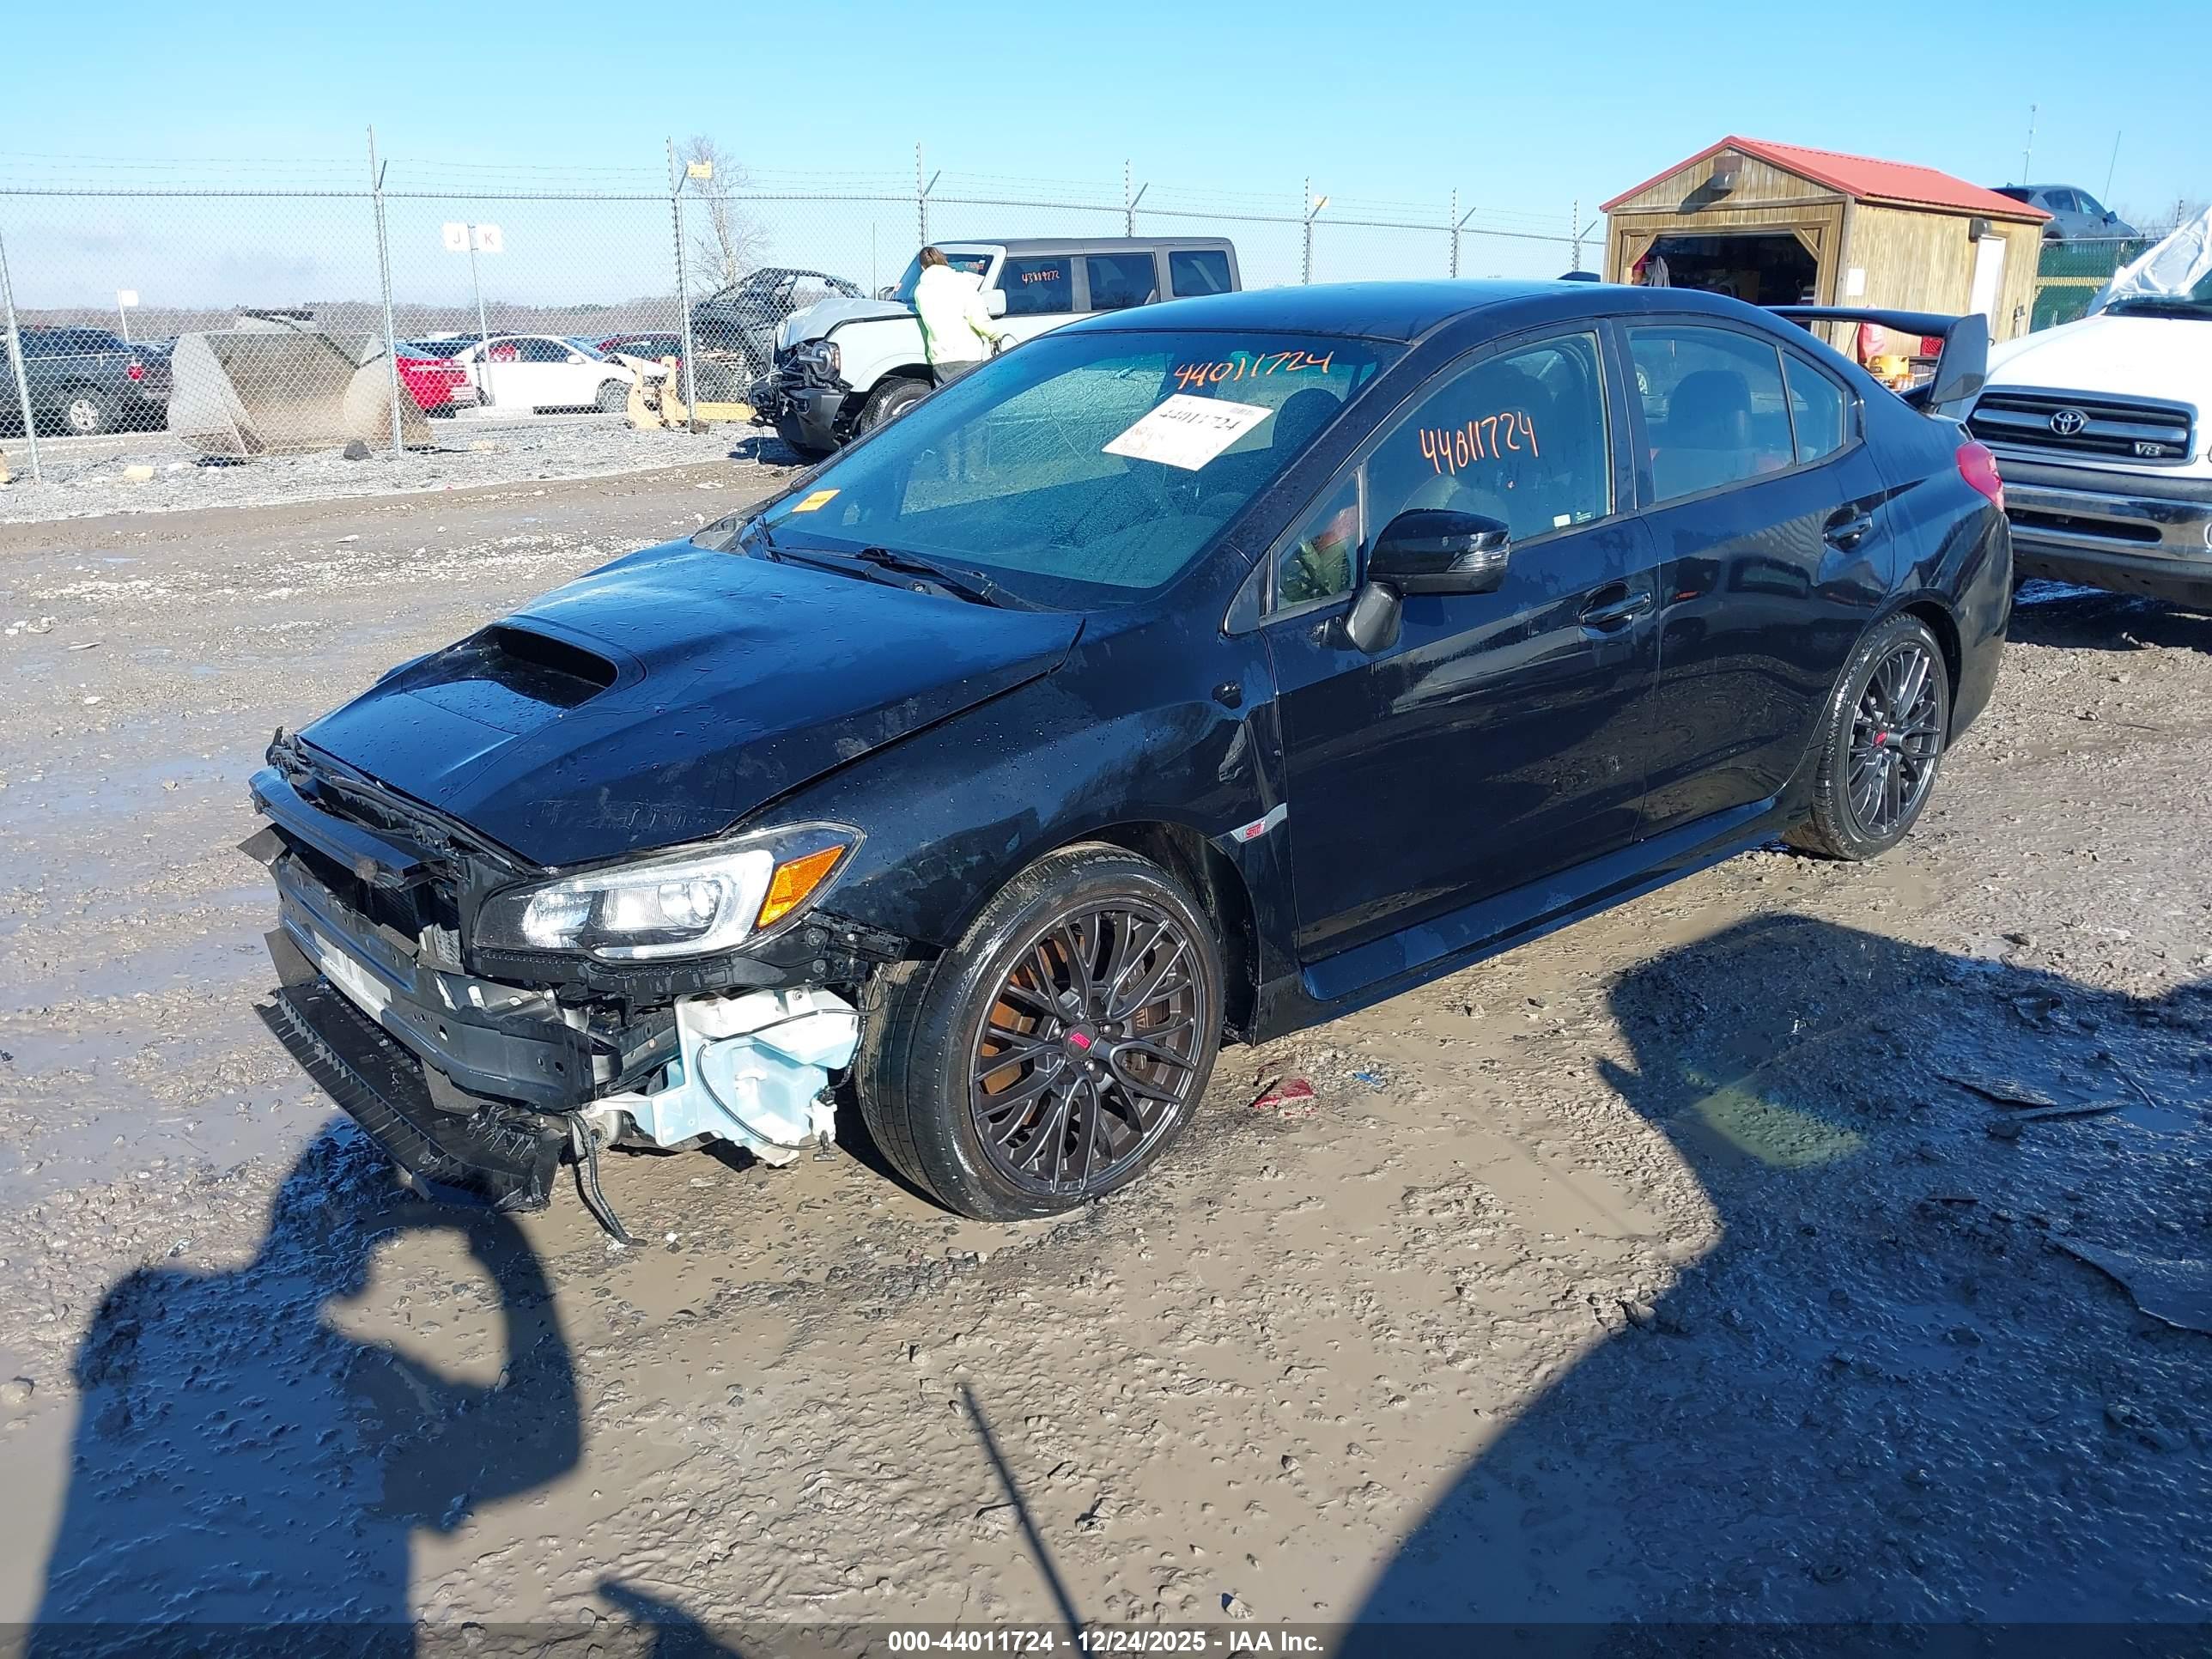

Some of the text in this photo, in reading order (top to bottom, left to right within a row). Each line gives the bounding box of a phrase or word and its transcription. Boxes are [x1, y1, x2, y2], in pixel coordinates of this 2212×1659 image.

[453, 231, 461, 244] J
[483, 233, 495, 246] K
[1173, 350, 1334, 390] 44011724
[1419, 410, 1540, 477] 44011724
[2135, 441, 2162, 457] V8
